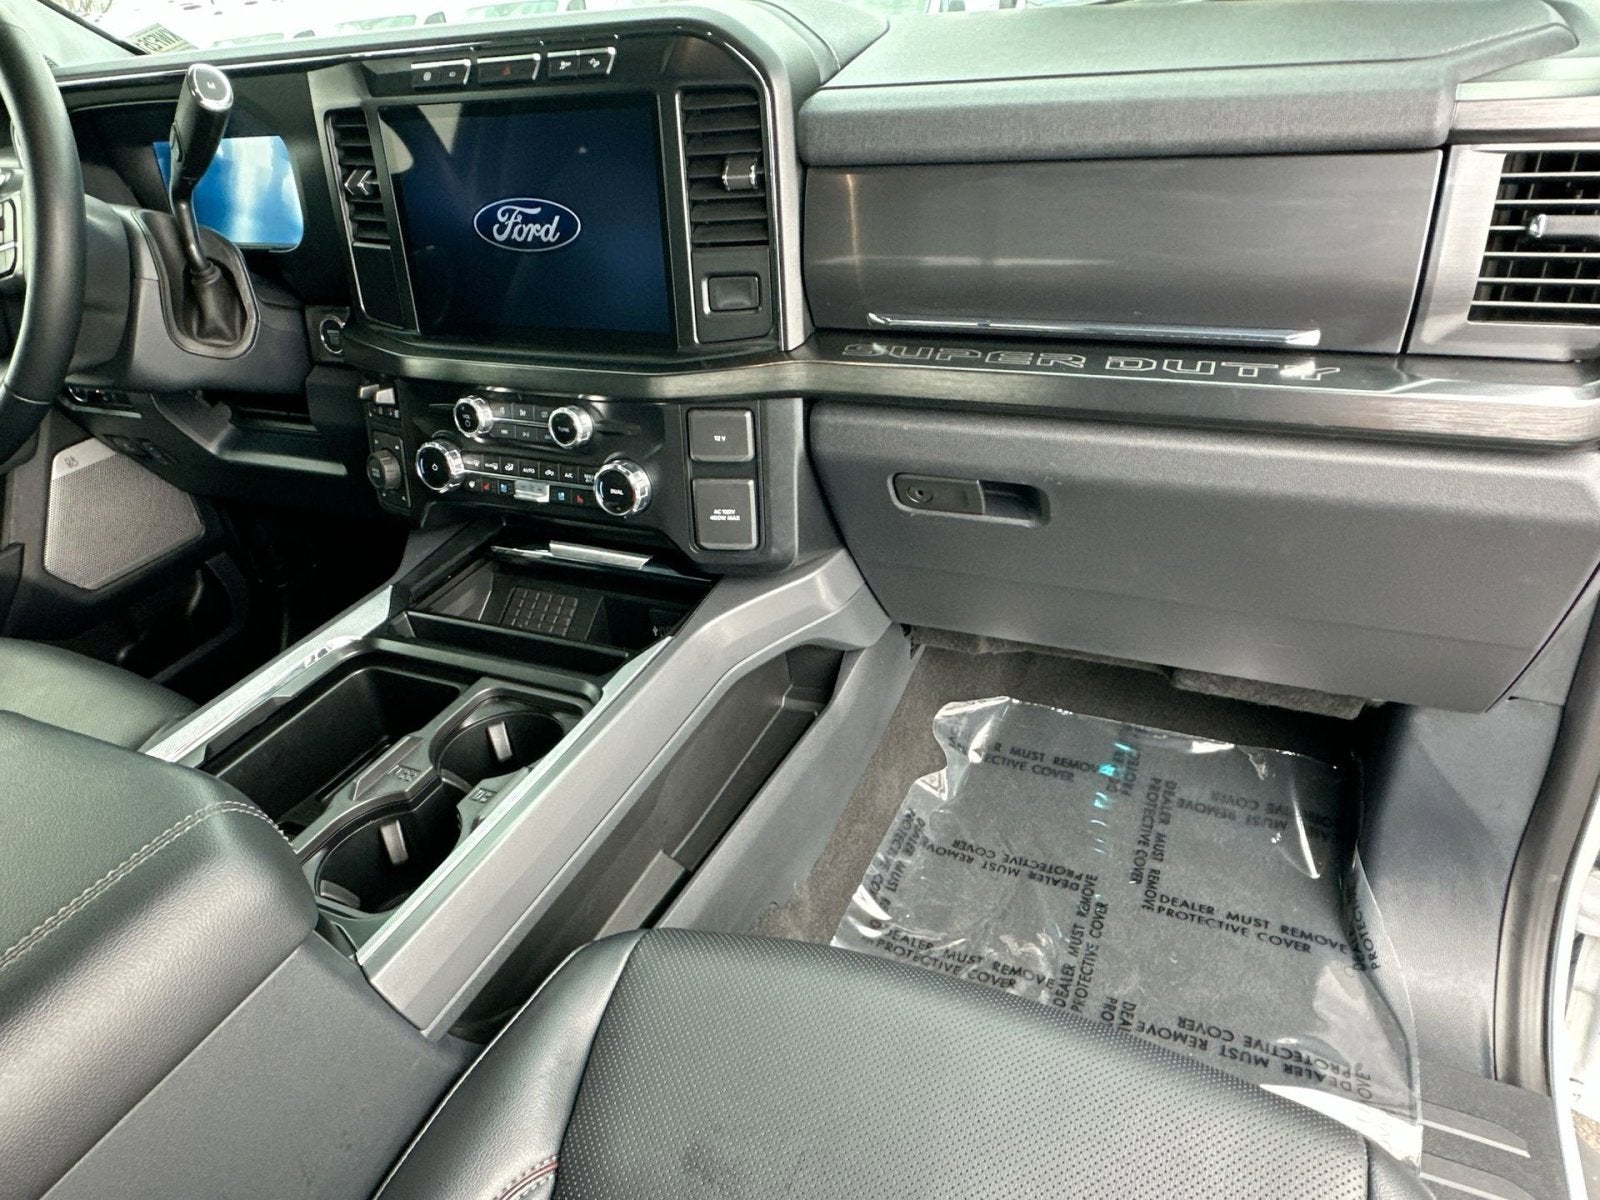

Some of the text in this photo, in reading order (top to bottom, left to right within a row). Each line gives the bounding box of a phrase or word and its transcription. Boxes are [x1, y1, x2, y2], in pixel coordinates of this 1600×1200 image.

[492, 205, 561, 243] Ford
[841, 343, 1341, 382] SUPER DUTY
[609, 488, 624, 496] DUAL
[1009, 746, 1046, 763] MUST
[1031, 764, 1075, 782] COVER
[1176, 798, 1237, 821] REMOVE
[1245, 814, 1288, 831] MUST
[902, 817, 926, 857] DEALER
[1129, 777, 1162, 885] PROTECTIVE COVER
[1141, 779, 1177, 911] DEALER MUST REMOVE
[885, 860, 907, 893] MUST
[952, 839, 1083, 881] PROTECTIVE COVER
[981, 862, 1021, 878] MUST
[1028, 871, 1080, 892] DEALER
[1053, 873, 1099, 1008] DEALER MUST REMOVE
[1157, 905, 1311, 953] PROTECTIVE COVER
[1159, 894, 1348, 955] DEALER MUST REMOVE
[875, 939, 1017, 989] PROTECTIVE COVER
[942, 948, 984, 964] MUST
[991, 960, 1056, 989] REMOVE
[1070, 901, 1109, 1014] PROTECTIVE COVER
[1117, 1001, 1137, 1033] DEAL
[1136, 1020, 1353, 1093] DEALER MUST REMOVE
[1177, 1015, 1351, 1076] PROTECTIVE COVER
